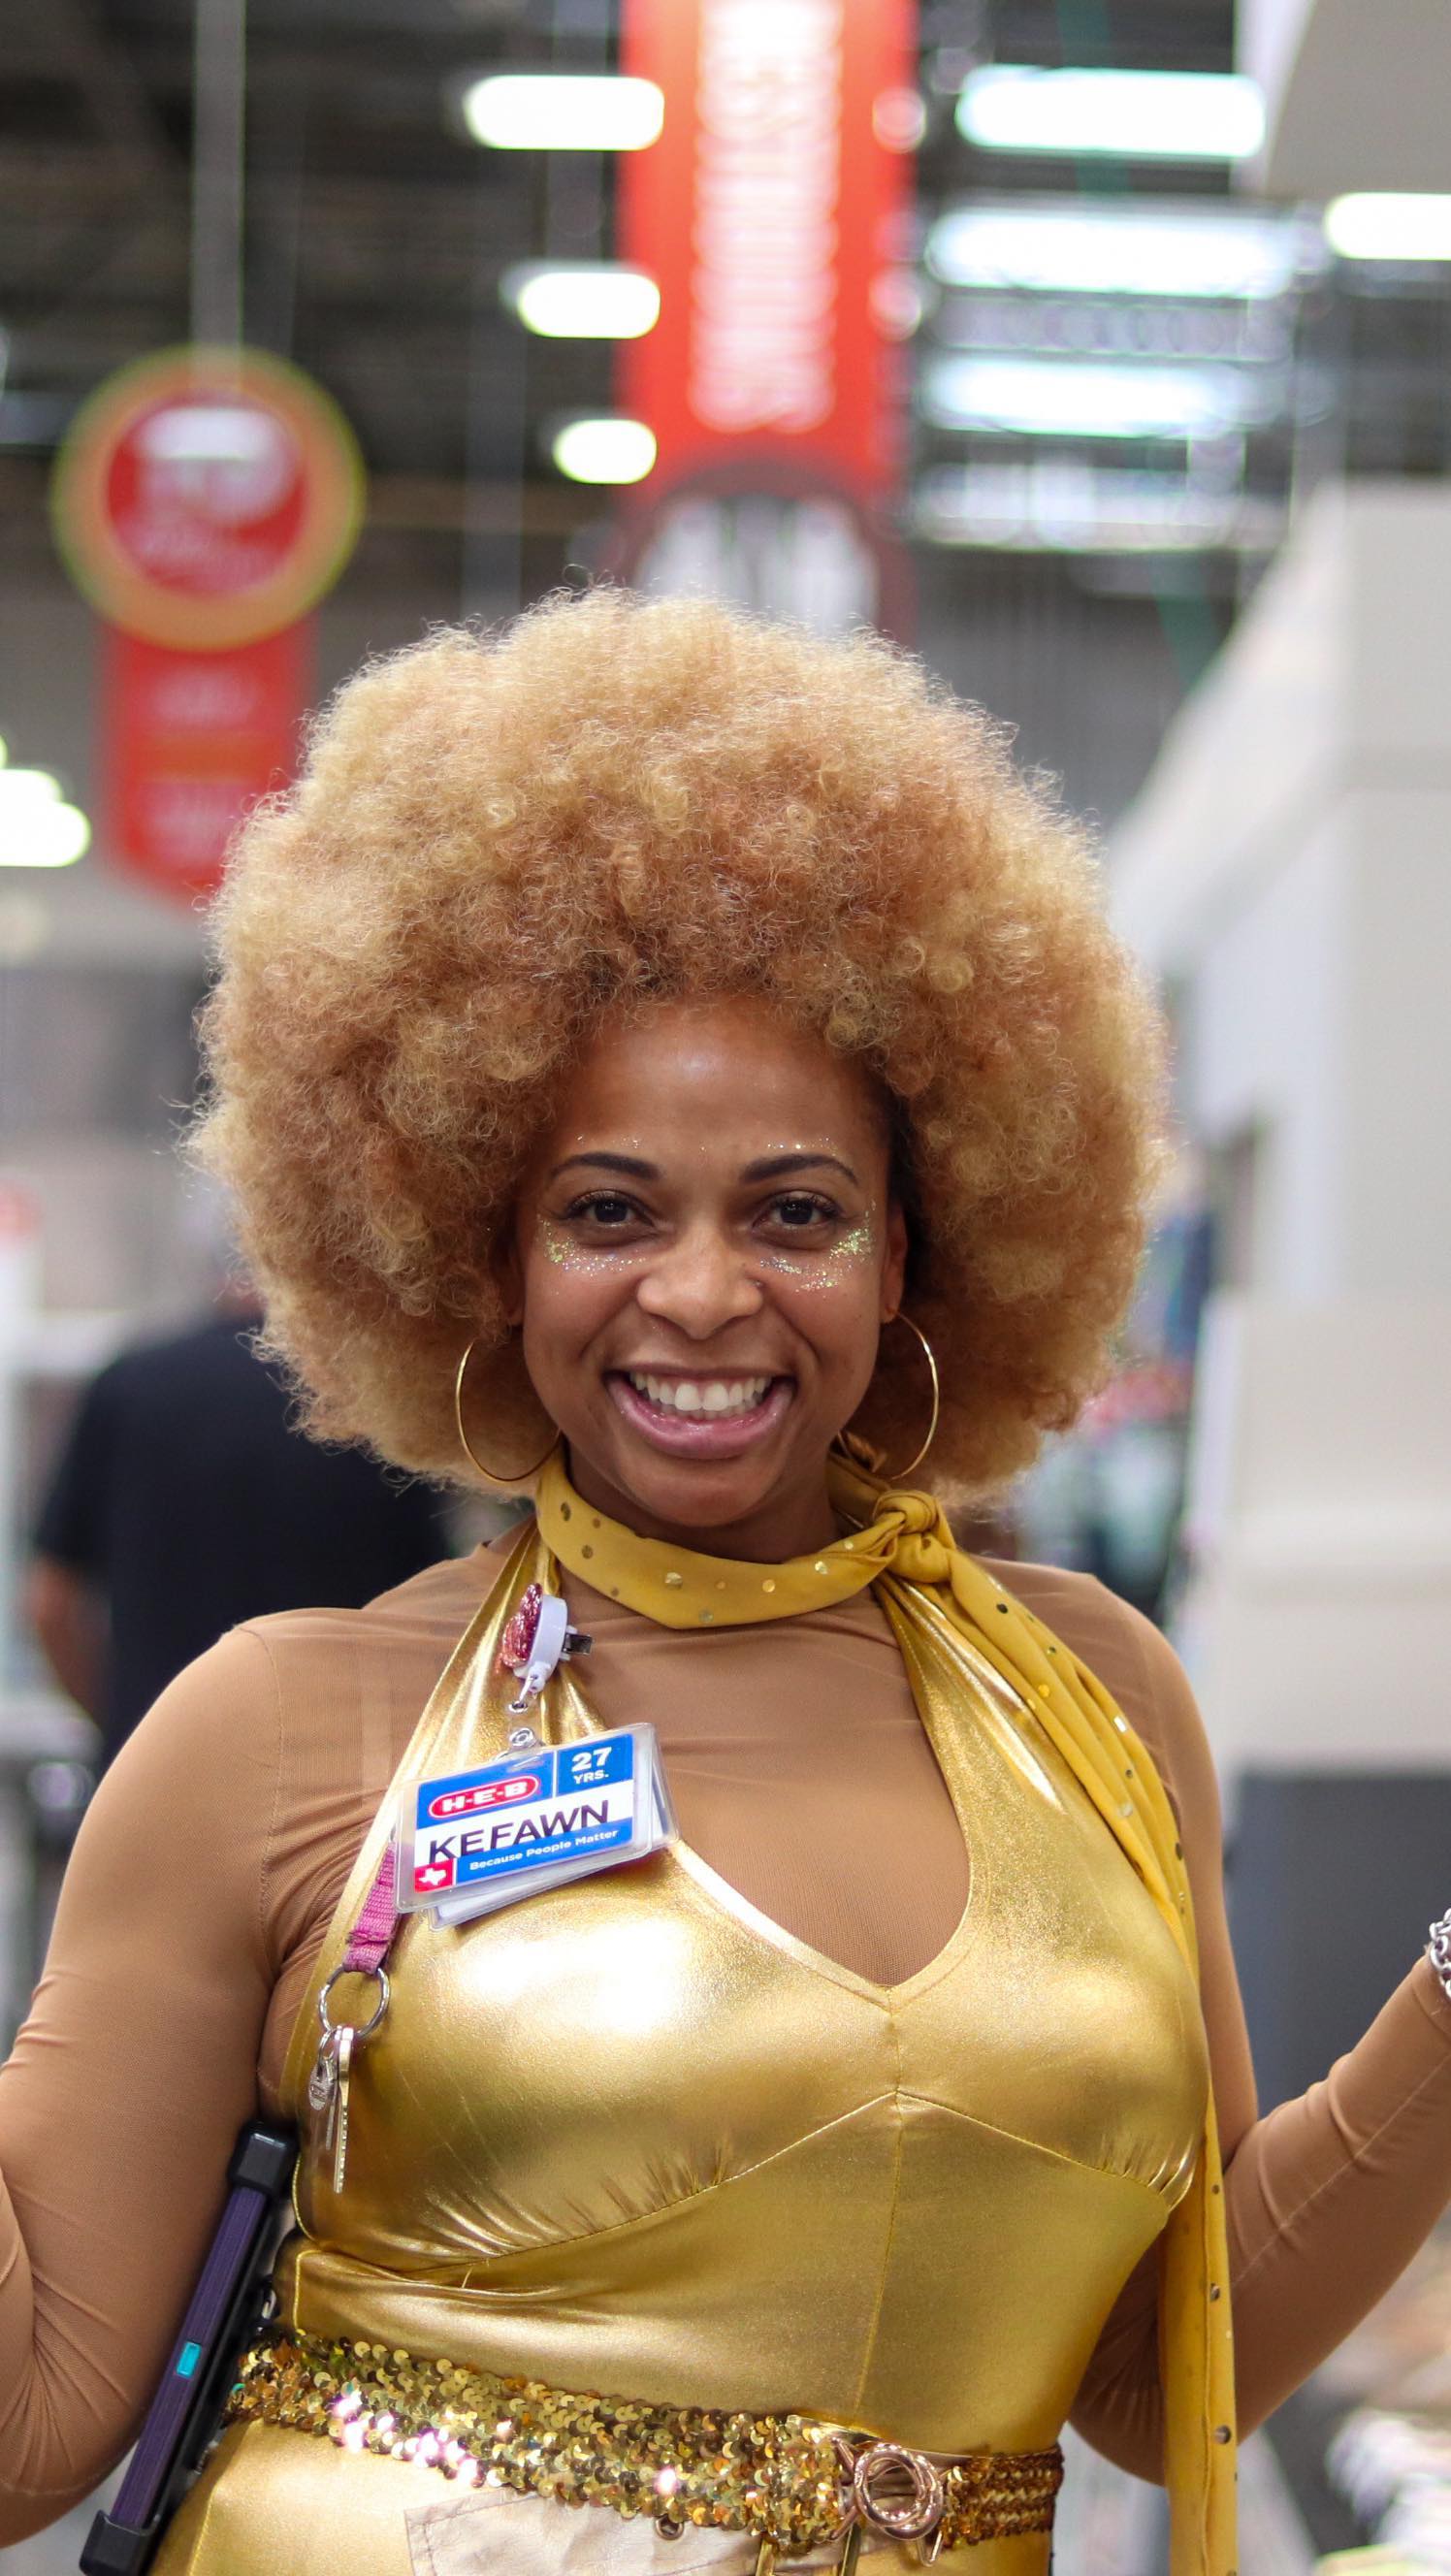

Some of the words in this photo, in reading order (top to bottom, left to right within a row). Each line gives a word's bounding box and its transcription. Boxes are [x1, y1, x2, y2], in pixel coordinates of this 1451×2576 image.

[571, 1747, 612, 1772] 27
[574, 1770, 609, 1785] YRS.
[441, 1782, 529, 1813] H-E-B
[429, 1800, 608, 1864] KEFAWN
[469, 1852, 523, 1870] Because
[527, 1841, 571, 1858] People
[575, 1828, 619, 1847] Matter
